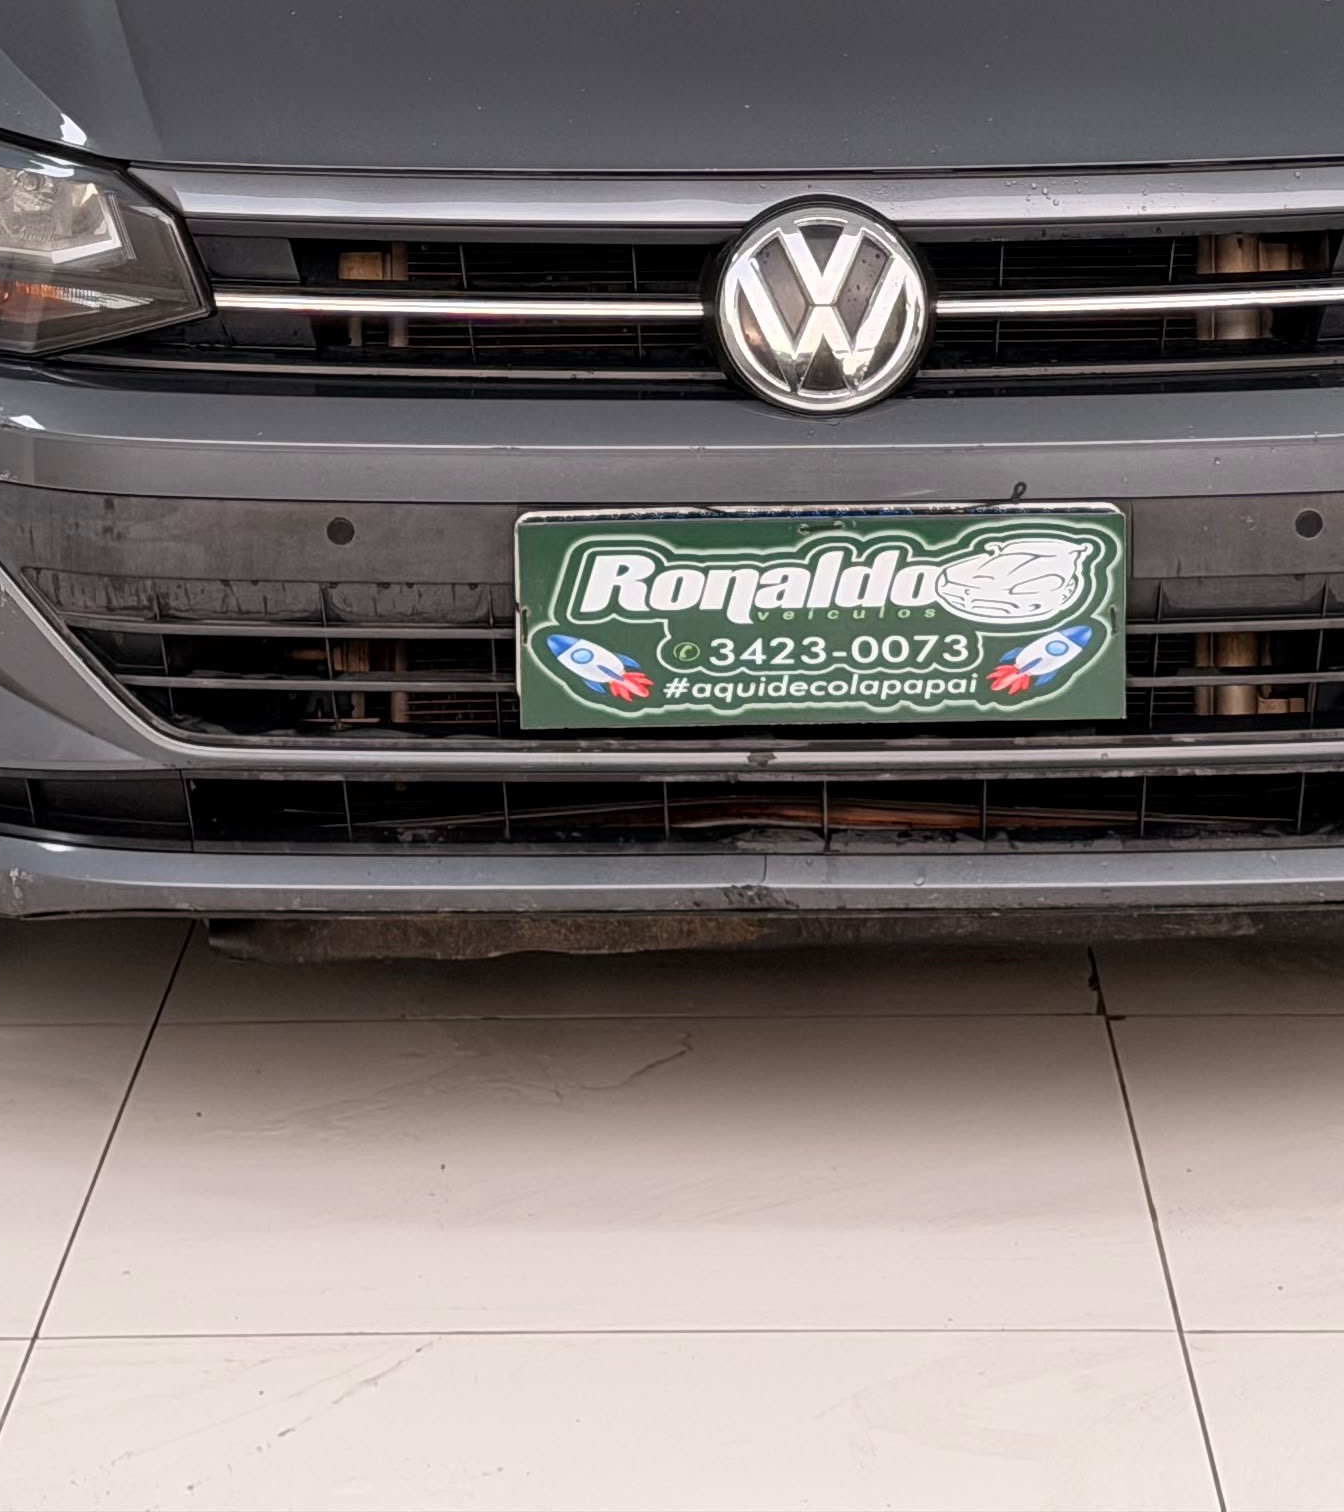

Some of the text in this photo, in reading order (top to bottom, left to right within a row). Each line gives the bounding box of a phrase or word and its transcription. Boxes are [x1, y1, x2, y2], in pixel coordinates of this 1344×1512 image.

[580, 550, 944, 624] Ronaldo
[709, 635, 969, 666] 3423-0073
[663, 673, 978, 703] #aquidecolapapai
